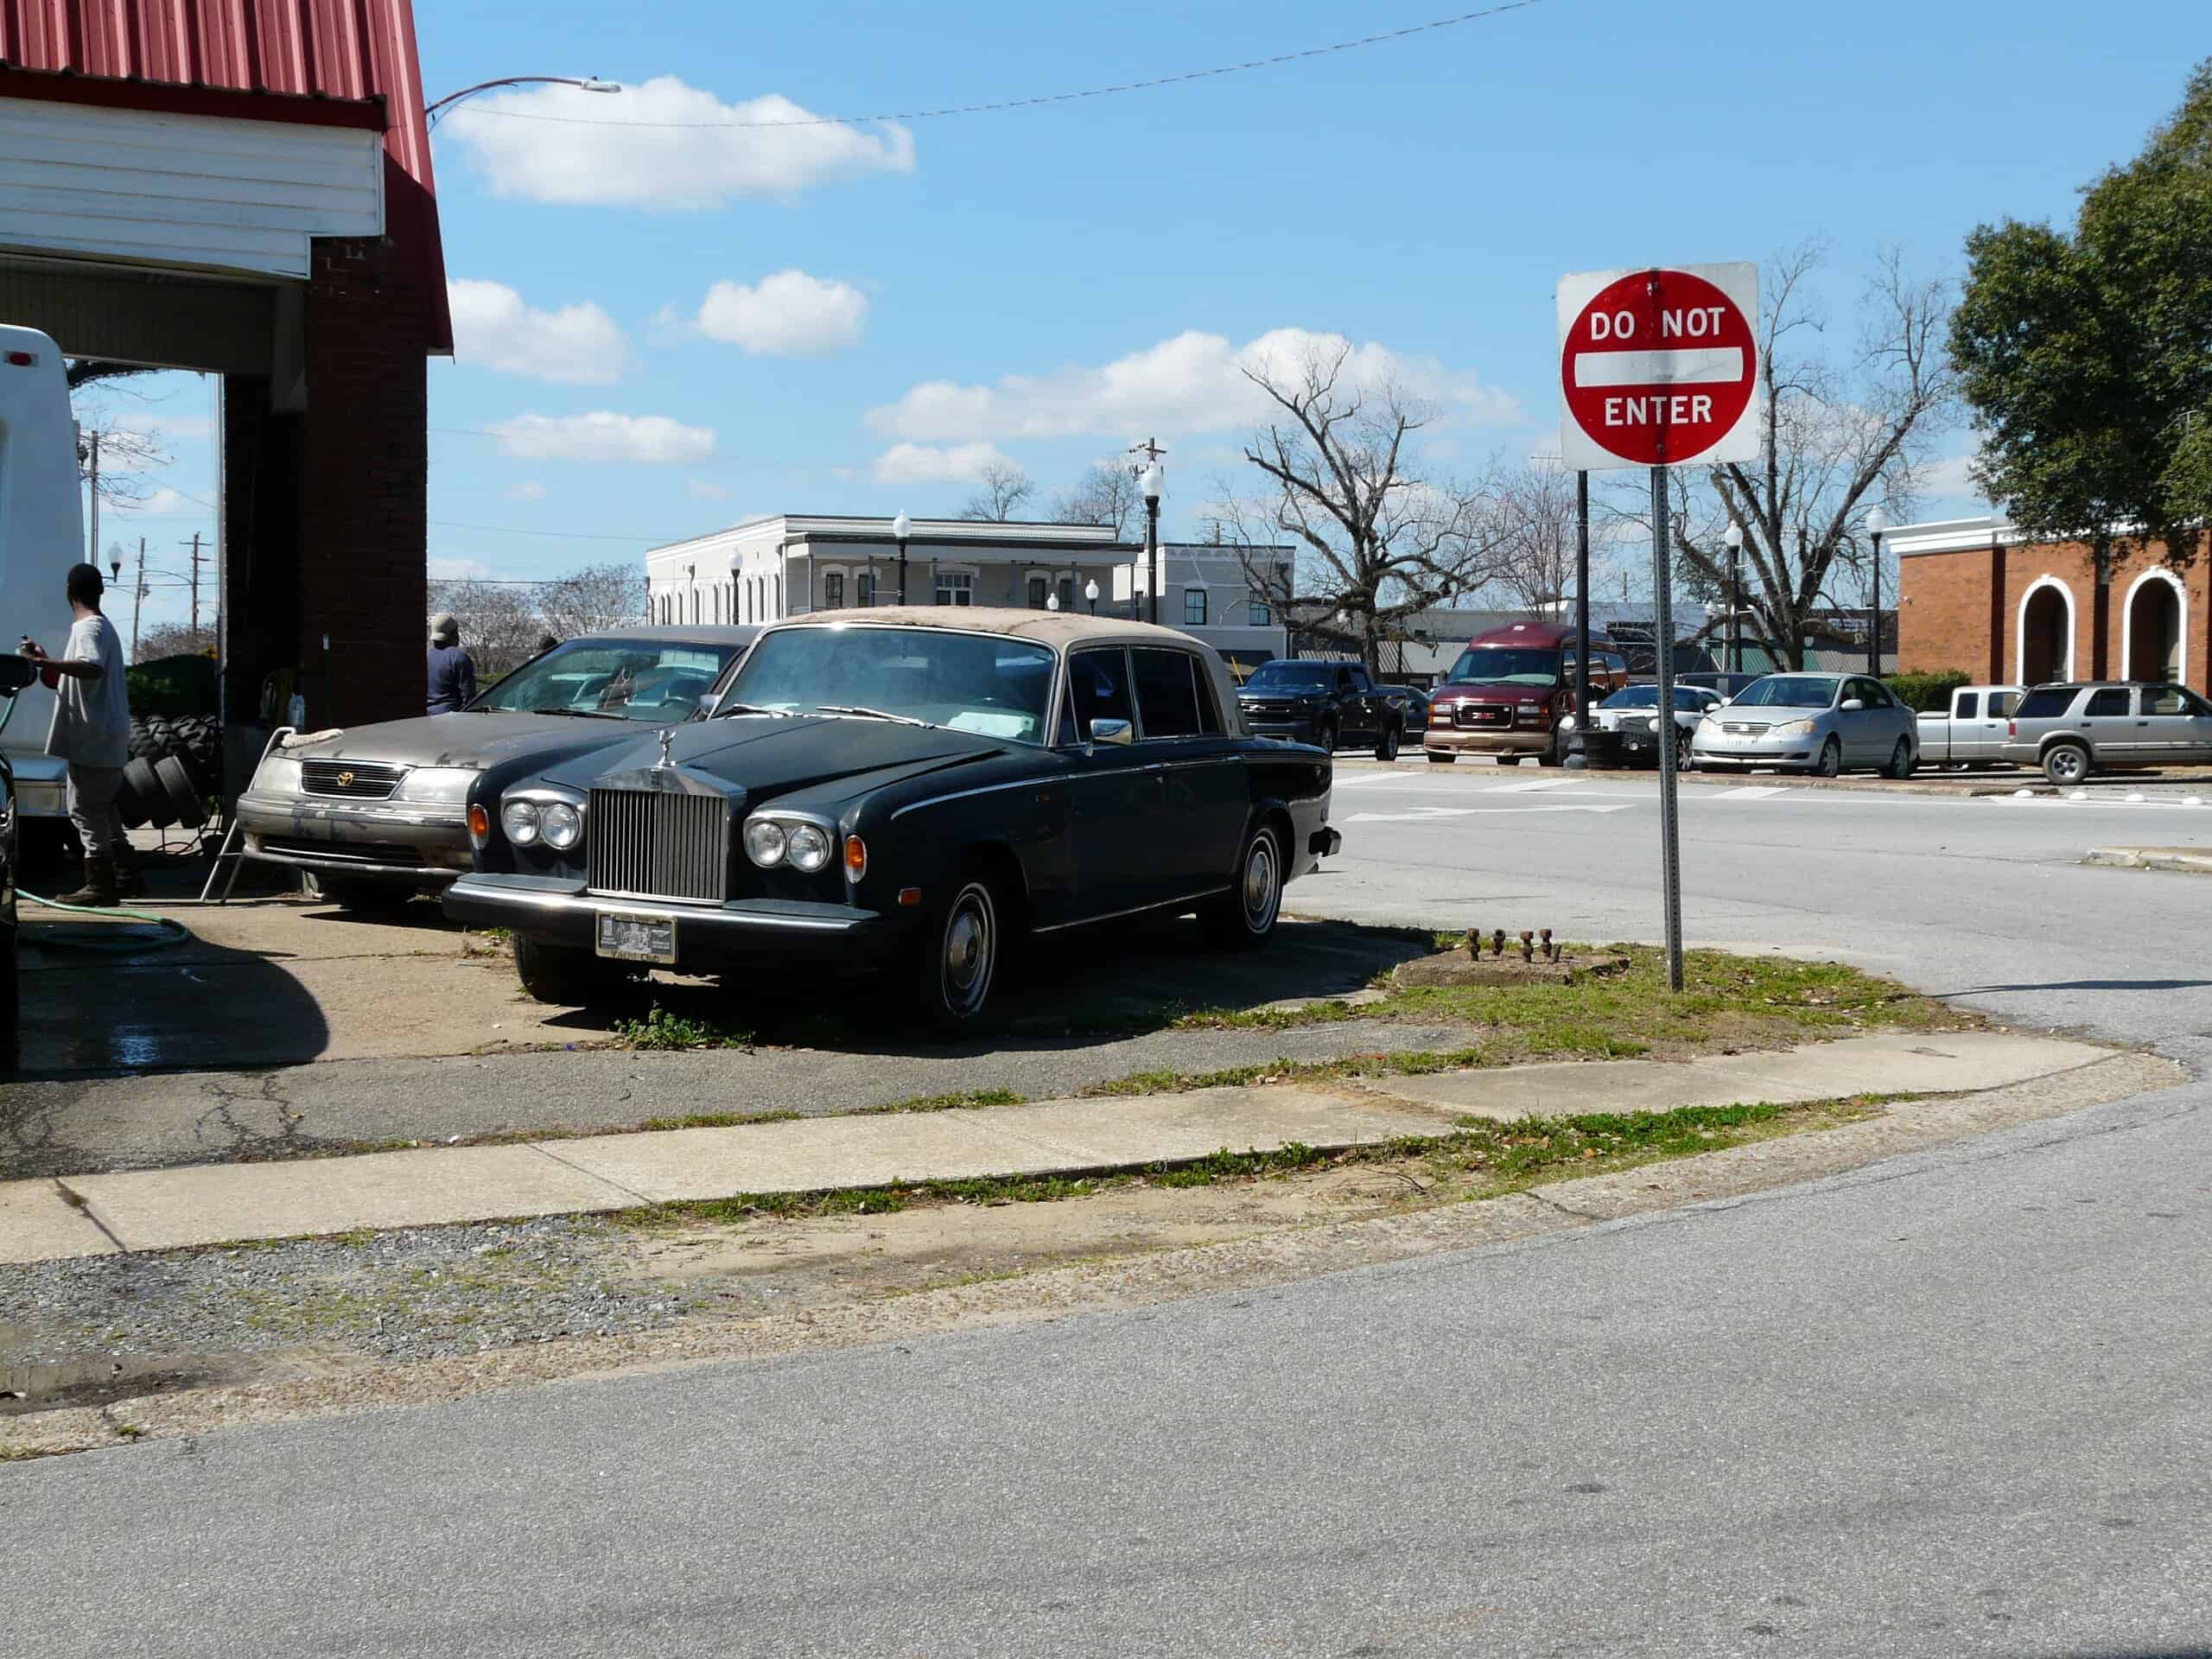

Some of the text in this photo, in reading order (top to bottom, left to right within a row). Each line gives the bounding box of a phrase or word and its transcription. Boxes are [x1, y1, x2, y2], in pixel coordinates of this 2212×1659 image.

[1590, 307, 1726, 340] DO NOT
[1605, 395, 1713, 426] ENTER
